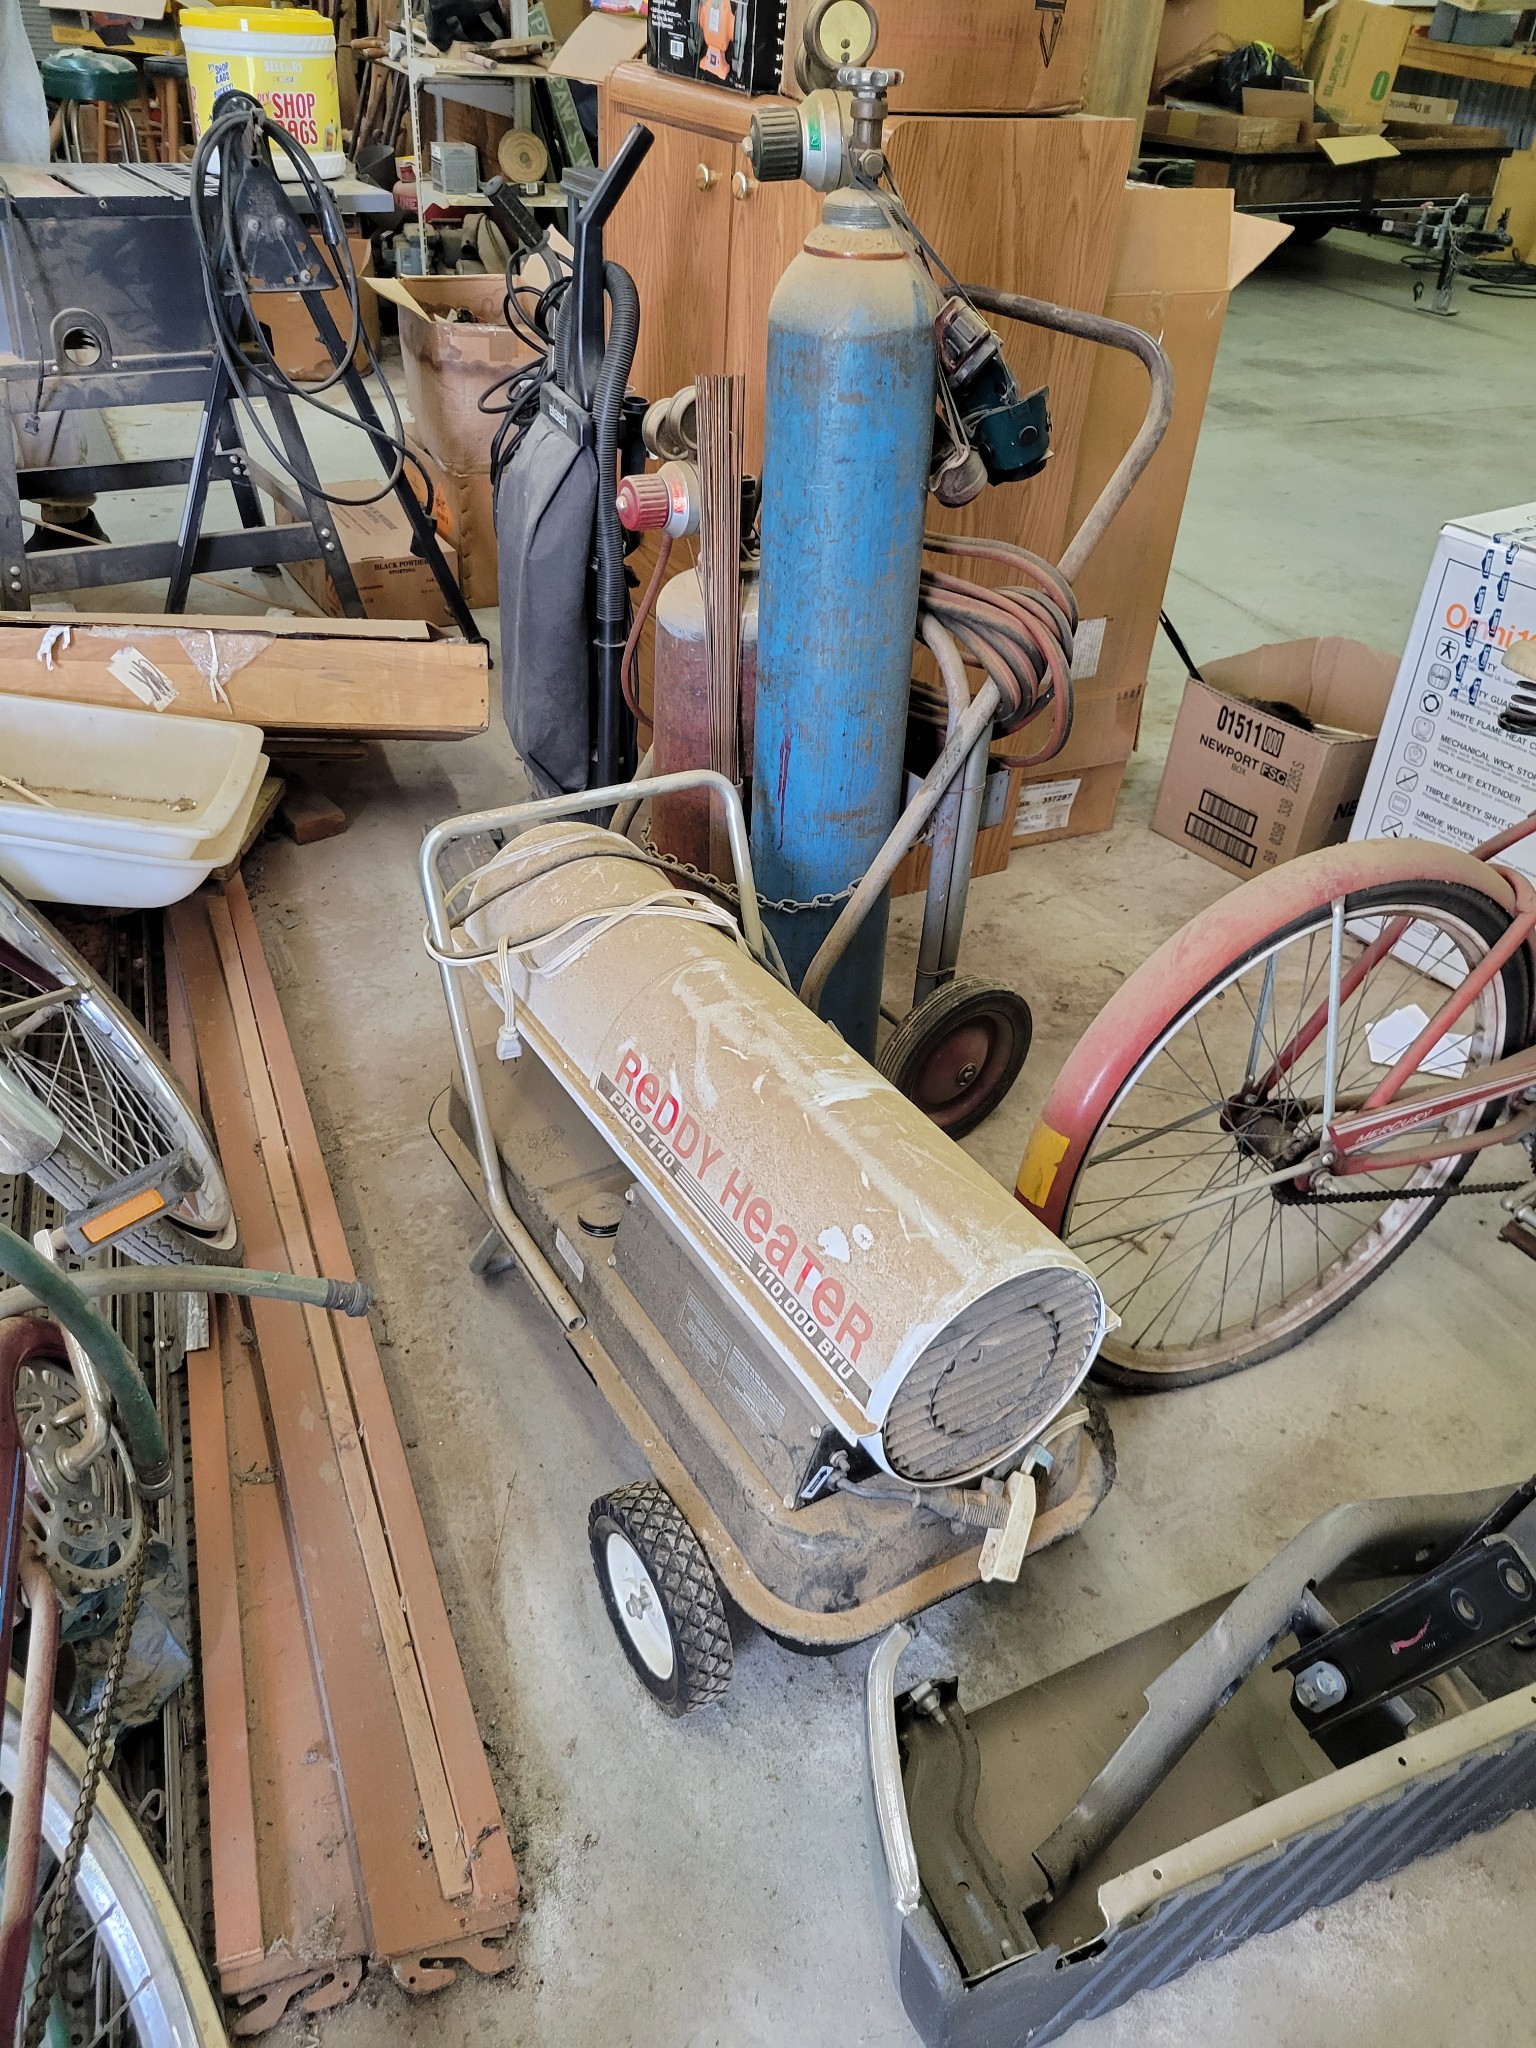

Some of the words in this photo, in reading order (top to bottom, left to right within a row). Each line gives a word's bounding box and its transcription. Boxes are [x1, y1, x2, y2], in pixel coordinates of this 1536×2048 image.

[215, 61, 229, 75] SHOP
[215, 71, 230, 85] RAGS
[272, 92, 316, 119] SHOP
[374, 562, 400, 571] BLACK
[1468, 655, 1497, 673] SATY
[1459, 682, 1488, 699] SATY
[1217, 705, 1262, 748] 01511
[1450, 707, 1475, 724] WHITE
[1476, 719, 1503, 737] FLAME
[1505, 731, 1528, 746] HEAT
[1200, 734, 1259, 770] NEWPORT
[1261, 763, 1287, 786] FSC
[1230, 763, 1248, 777] BOX
[1440, 734, 1490, 761] MECHANICAL
[1493, 756, 1515, 772] WICK
[1433, 759, 1454, 775] WICK
[1456, 769, 1475, 784] LIFE
[1475, 778, 1522, 804] EXTENDER
[1425, 784, 1451, 801] TRIPLE
[1451, 797, 1483, 815] SAFETY
[1483, 811, 1515, 830] SHUT-O
[1416, 808, 1445, 828] UNIQUE
[1446, 822, 1475, 843] WOVEN
[610, 1090, 647, 1133] PRO
[648, 1133, 676, 1168] 110
[1355, 1108, 1434, 1144] MERCURY
[757, 1261, 818, 1338] 110,000
[816, 1339, 855, 1381] BTU
